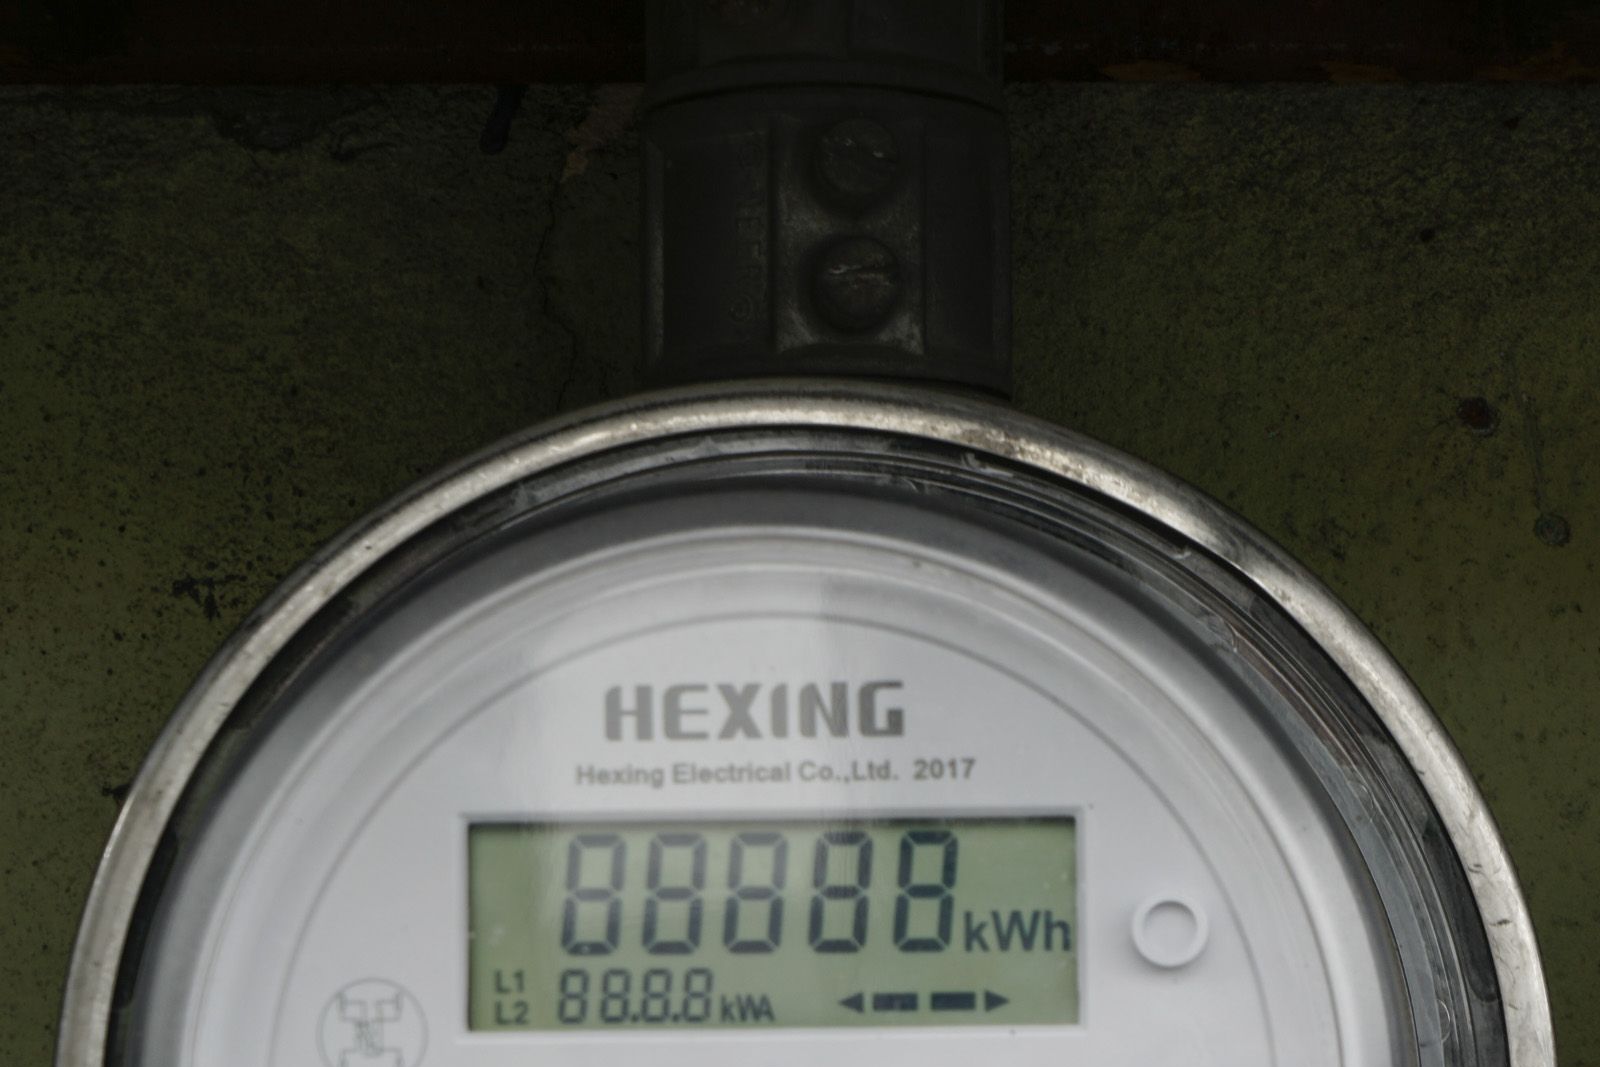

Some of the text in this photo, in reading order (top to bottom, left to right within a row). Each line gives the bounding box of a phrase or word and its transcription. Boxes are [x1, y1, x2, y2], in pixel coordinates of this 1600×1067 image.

[604, 680, 905, 741] HEXING
[576, 763, 664, 789] Hexing
[672, 761, 791, 784] Electrical
[912, 758, 975, 781] 2017
[561, 831, 1071, 956] 88888 kWh
[494, 970, 525, 993] L1
[494, 1001, 530, 1025] L2
